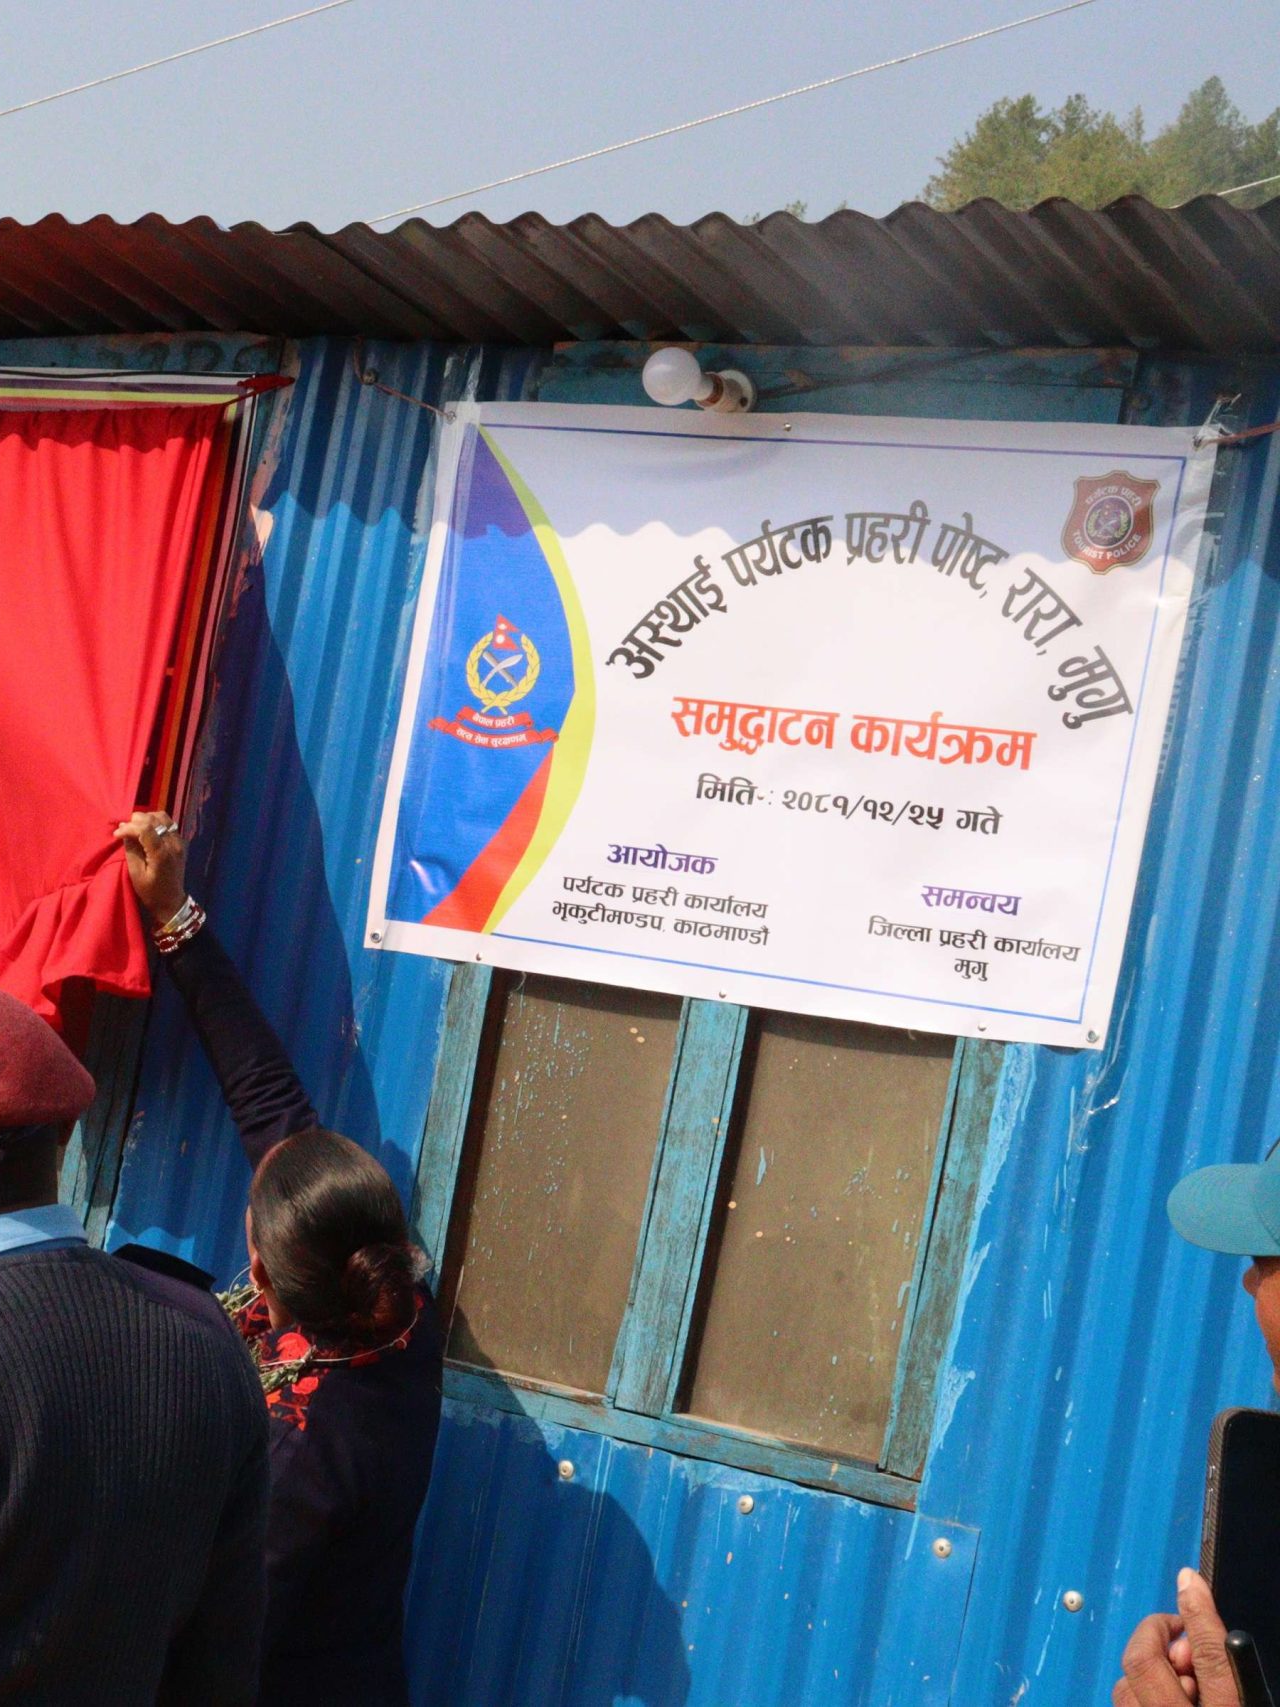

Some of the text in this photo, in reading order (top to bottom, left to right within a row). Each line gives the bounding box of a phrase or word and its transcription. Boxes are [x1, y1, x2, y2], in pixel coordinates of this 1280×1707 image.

[1072, 530, 1142, 560] TOURIST POLICE
[605, 554, 727, 679] अस्थाई
[721, 515, 833, 586] पर्यटक
[845, 500, 931, 565] प्रहरी
[1002, 567, 1083, 656] रारा,
[1047, 645, 1134, 729] मुगु
[850, 711, 1038, 770] कार्यक्रम
[956, 806, 1003, 835] गते
[607, 843, 718, 875] आयोजक
[562, 875, 769, 919] पर्यटक प्रहरी कार्यालय
[921, 885, 1022, 917] समन्वय
[868, 915, 1082, 962] जिल्ला प्रहरी कार्यालय
[954, 957, 989, 982] मुगु
